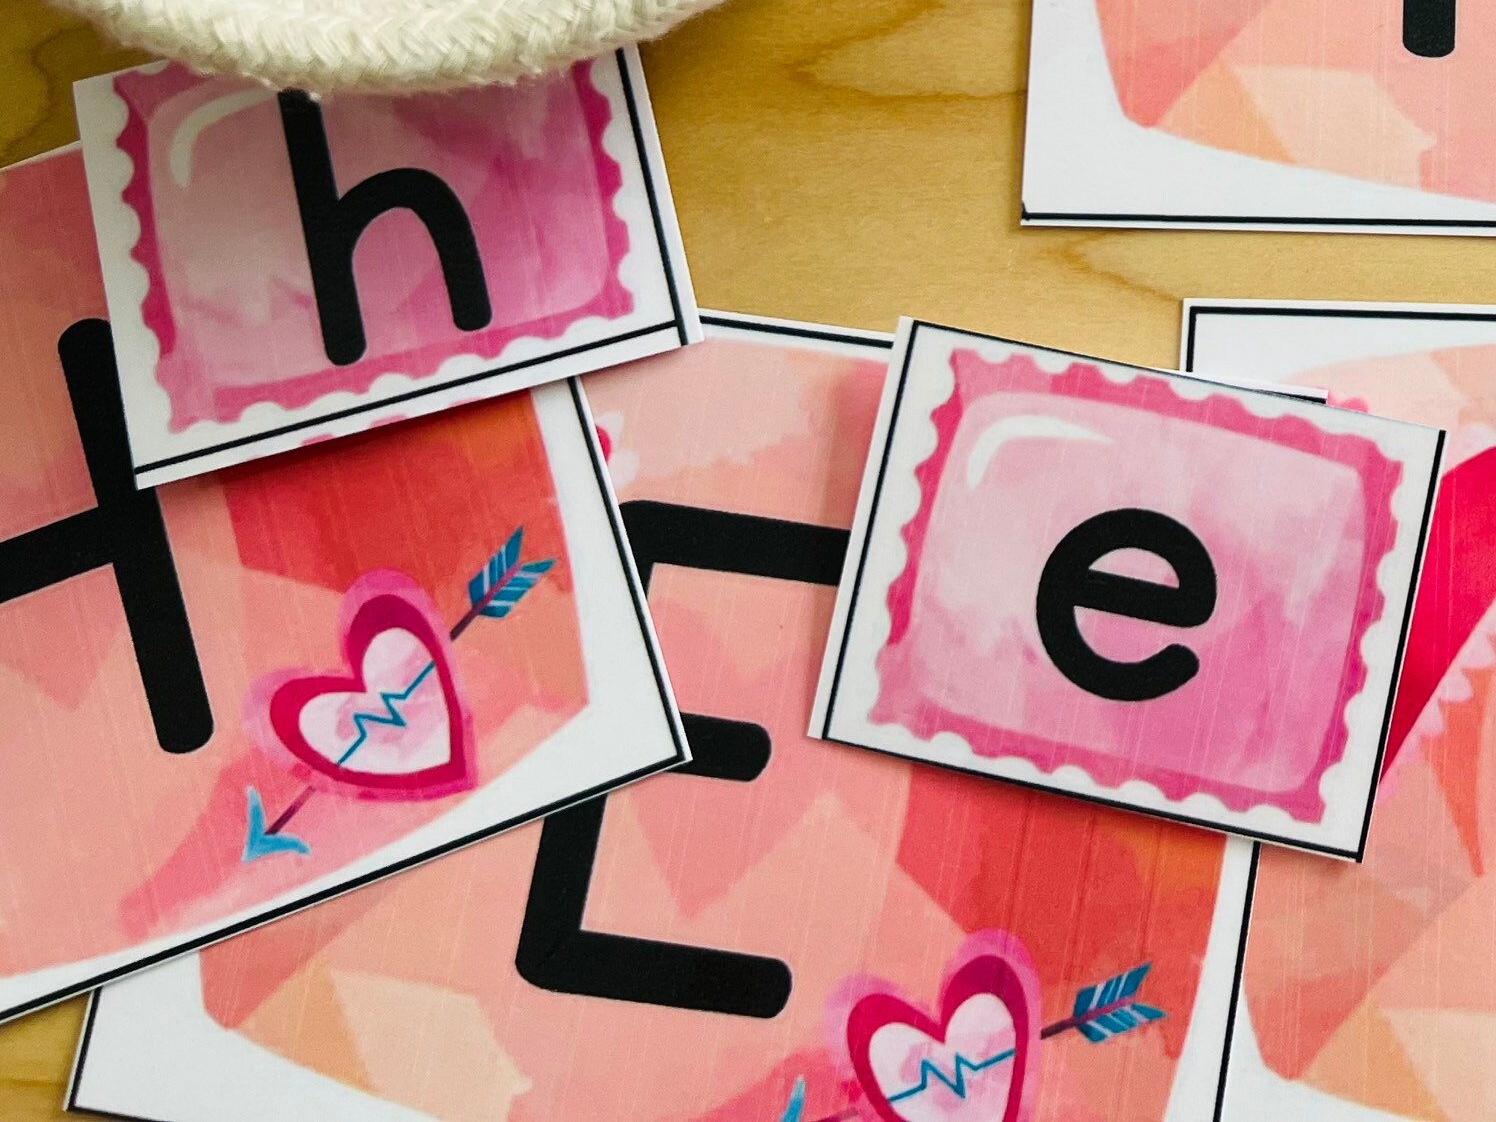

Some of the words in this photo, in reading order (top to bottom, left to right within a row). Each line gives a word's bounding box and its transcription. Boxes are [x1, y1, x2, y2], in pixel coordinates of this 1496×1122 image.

[278, 89, 492, 366] h
[1036, 508, 1217, 702] e
[515, 499, 851, 1019] E
